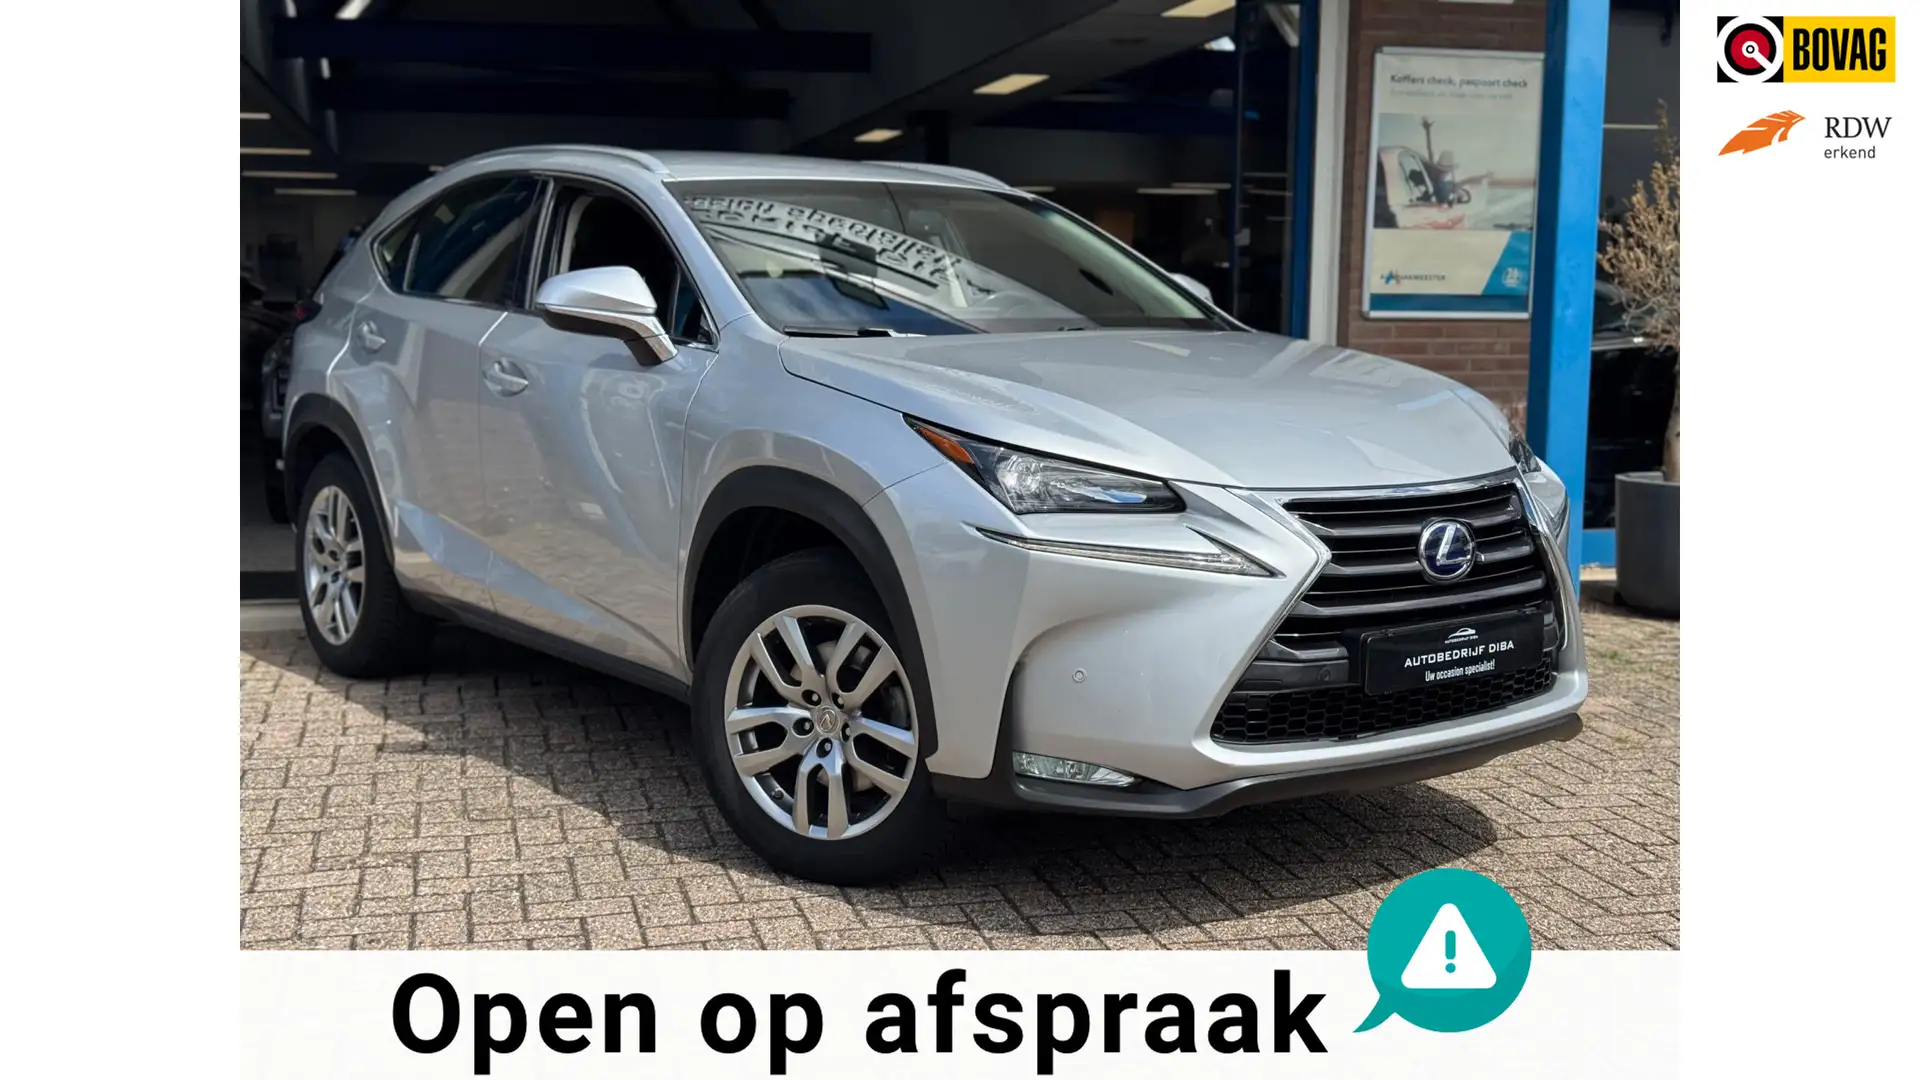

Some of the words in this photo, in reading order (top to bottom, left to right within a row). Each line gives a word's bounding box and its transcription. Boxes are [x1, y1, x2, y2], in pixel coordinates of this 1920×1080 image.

[1390, 75, 1425, 85] Koffers
[1502, 79, 1528, 88] check
[1404, 645, 1486, 668] AUTOBEDRIJF
[1488, 640, 1515, 653] DIBA
[1425, 670, 1435, 682] Uw
[1436, 666, 1464, 680] occasion
[1464, 659, 1496, 676] specialist!
